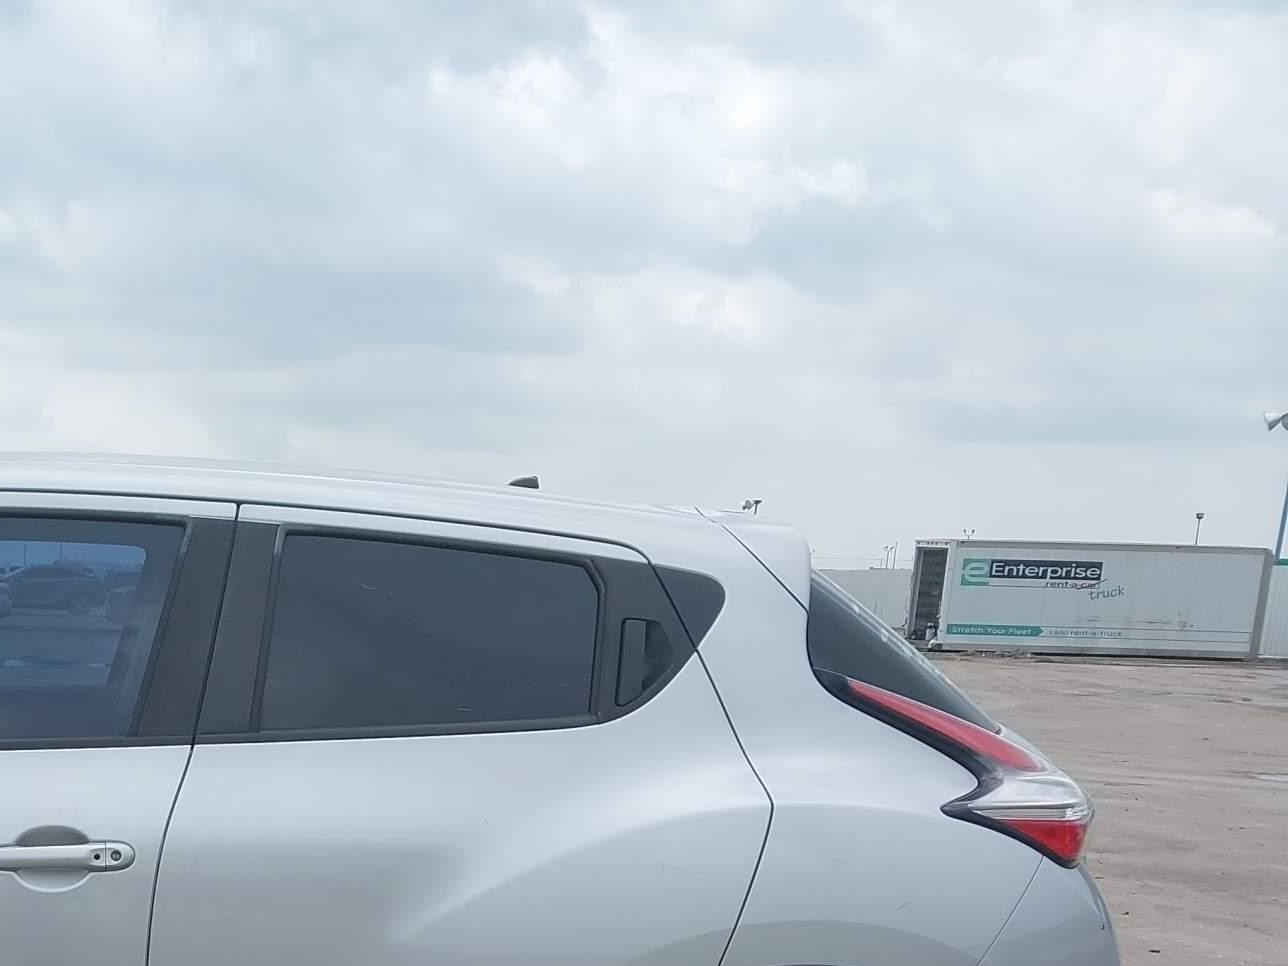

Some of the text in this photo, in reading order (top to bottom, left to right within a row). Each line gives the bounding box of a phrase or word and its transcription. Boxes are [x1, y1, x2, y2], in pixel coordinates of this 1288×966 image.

[991, 562, 1101, 580] Enterprise
[1088, 585, 1125, 600] truck
[1008, 627, 1032, 635] Fleet
